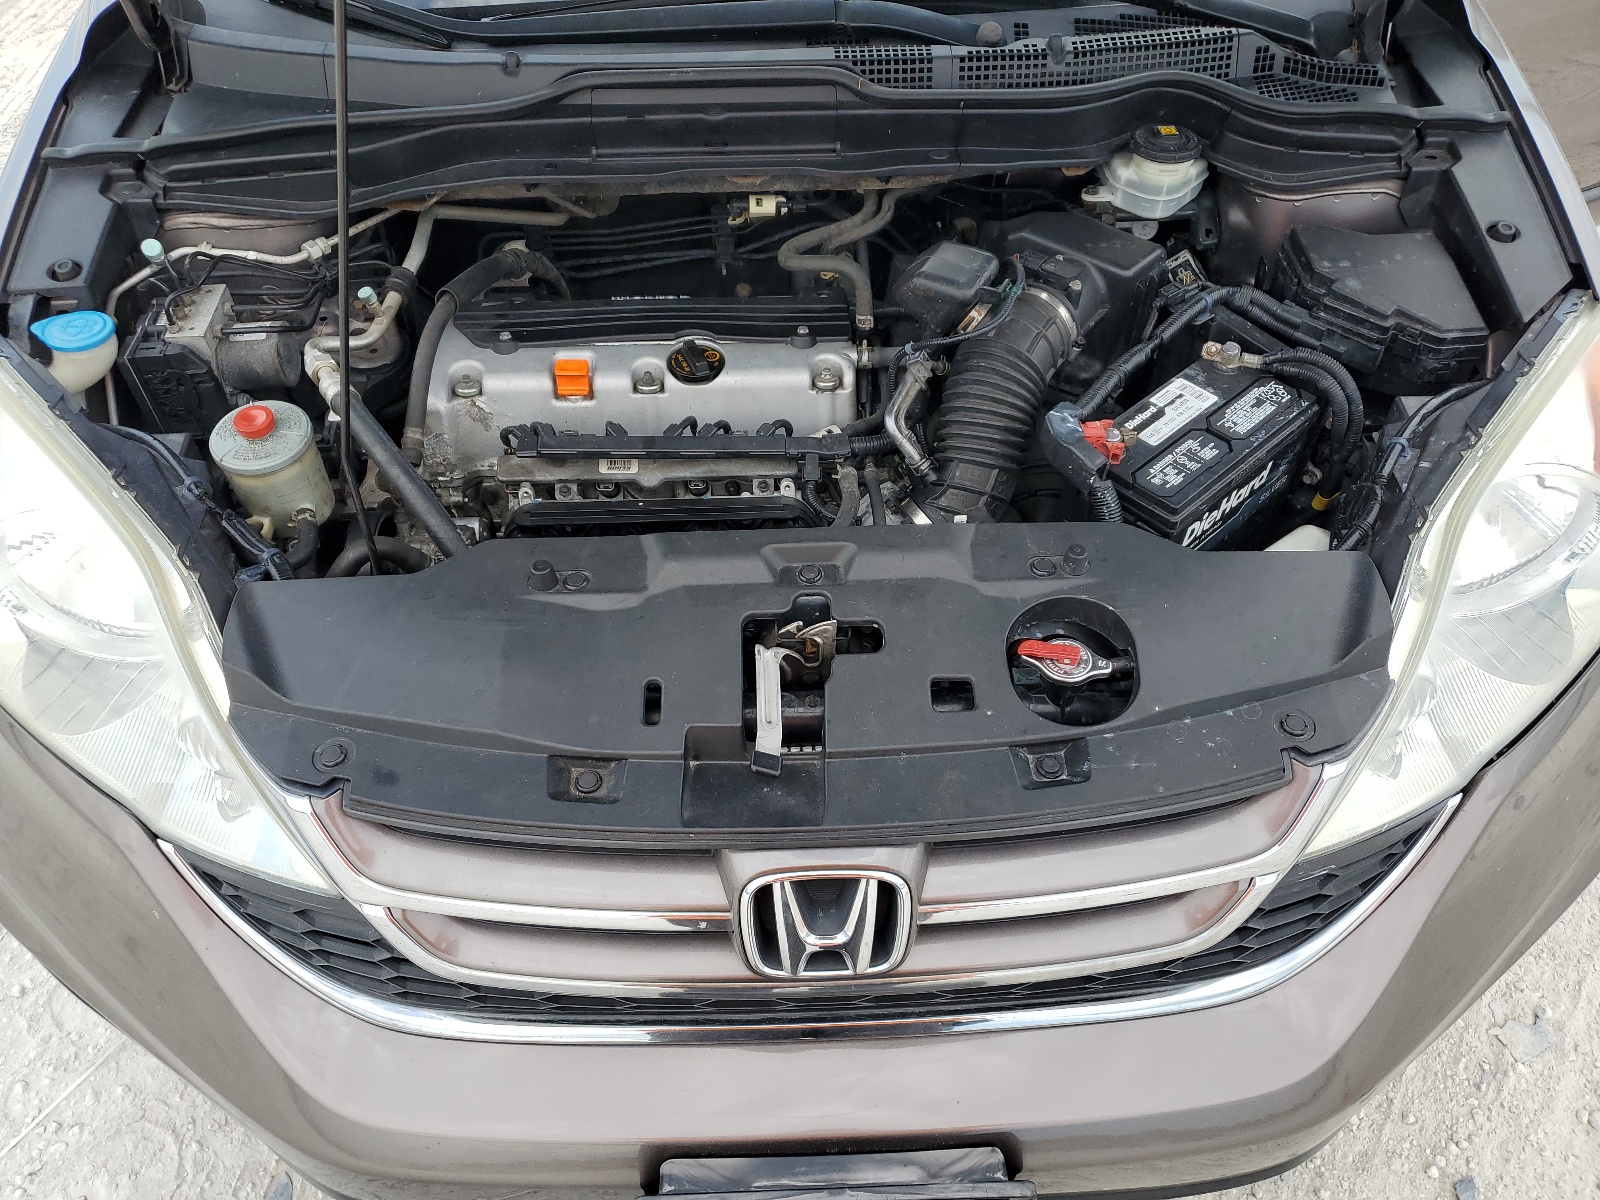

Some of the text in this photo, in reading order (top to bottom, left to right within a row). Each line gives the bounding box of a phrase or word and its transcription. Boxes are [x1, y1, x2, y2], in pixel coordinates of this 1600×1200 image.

[1124, 405, 1158, 430] DieHard
[1152, 454, 1174, 471] DANGER
[1182, 460, 1274, 547] DieHard
